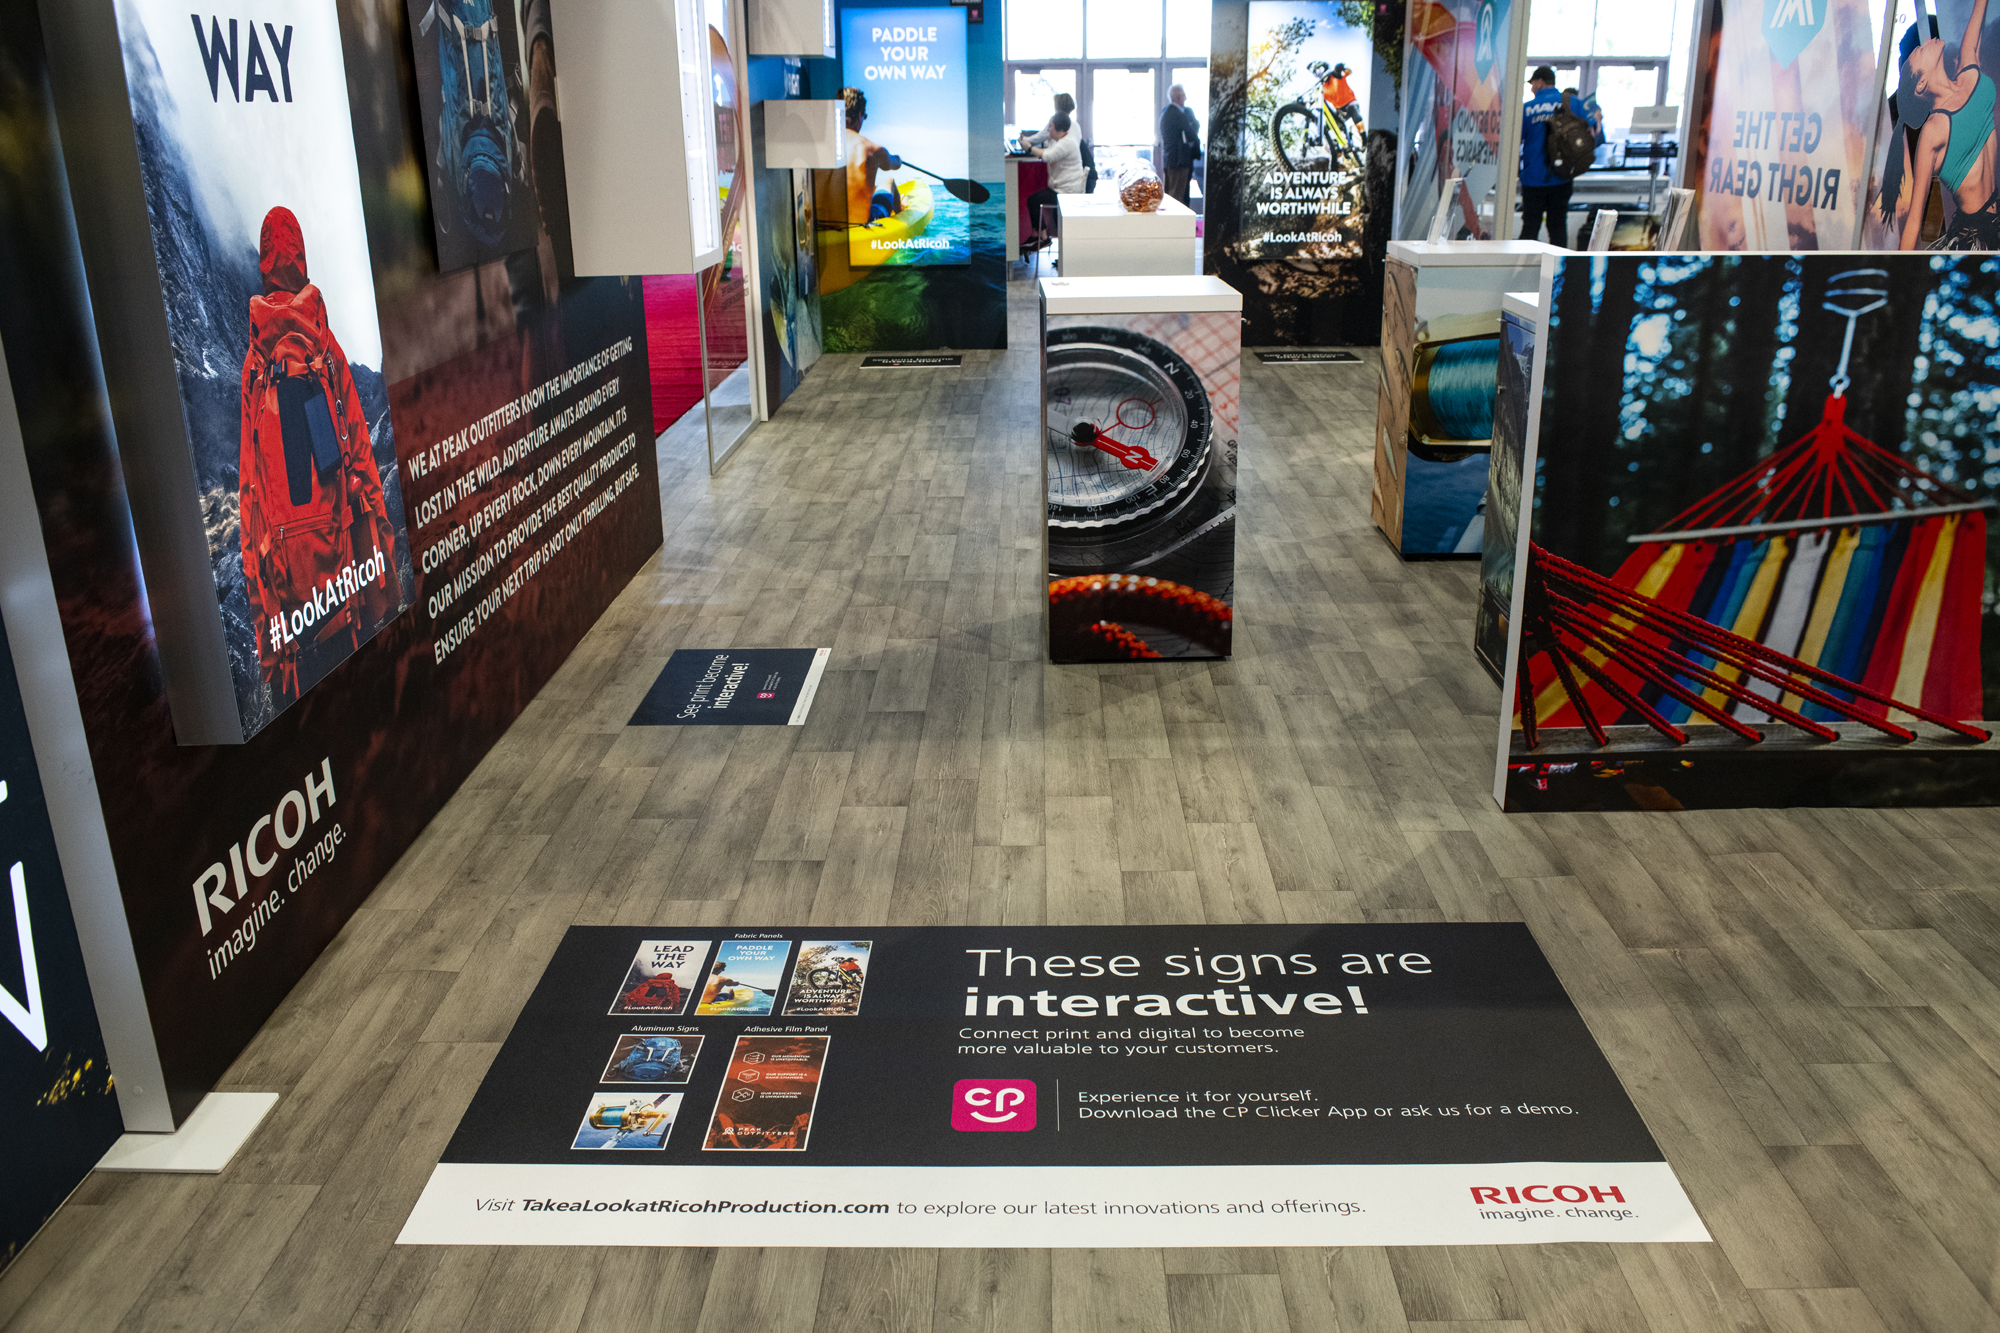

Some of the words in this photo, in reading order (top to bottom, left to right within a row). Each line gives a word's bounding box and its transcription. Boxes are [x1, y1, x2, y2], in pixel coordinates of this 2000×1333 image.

[872, 27, 937, 42] PADDLE
[190, 14, 294, 103] WAY
[880, 46, 928, 61] YOUR
[864, 65, 906, 80] OWN
[910, 64, 946, 80] WAY
[1263, 172, 1346, 185] ADVENTURE
[1270, 187, 1282, 200] IS
[1285, 187, 1338, 200] ALWAYS
[1256, 202, 1352, 215] WORTHWHILE
[870, 238, 950, 250] #LookAtRicoh
[1262, 232, 1342, 243] #LookAtRicoh
[1164, 362, 1180, 375] N
[1184, 390, 1194, 400] 20
[408, 452, 428, 482] WE
[429, 444, 440, 472] AT
[442, 428, 470, 462] PEAK
[470, 399, 520, 445] OUTFITTERS
[520, 386, 546, 417] KNOW
[545, 377, 560, 400] THE
[560, 359, 601, 394] IMPORTANCE
[600, 348, 610, 371] OF
[609, 336, 633, 366] GETTING
[1190, 420, 1198, 429] 40
[415, 495, 442, 528] LOST
[444, 486, 456, 511] IN
[456, 469, 476, 500] THE
[476, 454, 502, 488] WILD.
[502, 422, 549, 470] ADVENTURE
[550, 407, 574, 438] AWAITS
[575, 390, 602, 422] AROUND
[601, 376, 620, 405] EVERY
[1125, 449, 1143, 464] N
[1180, 448, 1190, 458] 60
[1160, 474, 1170, 484] 80
[422, 525, 470, 574] CORNER,
[469, 512, 483, 537] UP
[484, 488, 512, 528] EVERY
[512, 472, 538, 505] ROCK,
[538, 458, 562, 488] DOWN
[562, 438, 584, 470] EVERY
[620, 406, 628, 423] IS
[1146, 484, 1158, 496] E
[1126, 494, 1140, 504] 100
[428, 583, 452, 619] OUR
[454, 548, 494, 600] MISSION
[494, 539, 507, 564] TO
[507, 512, 543, 554] PROVIDE
[542, 494, 558, 523] THE
[557, 483, 574, 514] BEST
[574, 462, 600, 498] QUALITY
[599, 442, 629, 479] PRODUCTS
[628, 432, 636, 450] TO
[434, 611, 476, 665] ENSURE
[475, 587, 501, 626] YOUR
[502, 566, 524, 602] NEXT
[523, 551, 542, 582] TRIP
[542, 543, 550, 564] IS
[550, 529, 565, 557] NOT
[564, 514, 582, 542] ONLY
[582, 486, 616, 526] THRILLING,
[615, 476, 626, 498] BUT
[626, 462, 640, 488] SAFE.
[269, 545, 386, 652] #LookAtRicoh
[696, 654, 729, 684] become
[690, 684, 711, 703] print
[707, 663, 749, 709] interactive!
[676, 704, 701, 719] See
[192, 756, 336, 938] RICOH
[208, 890, 286, 980] imagine.
[288, 823, 346, 892] change.
[966, 947, 1140, 977] These
[1165, 947, 1317, 984] signs
[1341, 952, 1432, 975] are
[965, 986, 1369, 1017] interactive!
[959, 1027, 1039, 1039] Connect
[1045, 1027, 1090, 1041] print
[1096, 1027, 1131, 1039] and
[1138, 1027, 1196, 1042] digital
[1203, 1027, 1223, 1039] to
[1229, 1026, 1304, 1039] become
[958, 1045, 1007, 1054] more
[1013, 1043, 1092, 1054] valuable
[1098, 1044, 1119, 1054] to
[1125, 1046, 1169, 1057] your
[1175, 1044, 1278, 1054] customers.
[1079, 1091, 1180, 1105] Experience
[1186, 1090, 1199, 1102] it
[1204, 1090, 1232, 1102] for
[1238, 1090, 1318, 1104] yourself.
[1079, 1107, 1178, 1119] Download
[1184, 1107, 1216, 1118] the
[1223, 1107, 1249, 1118] CP
[1256, 1106, 1320, 1118] Clicker
[1328, 1106, 1368, 1119] App
[1374, 1107, 1393, 1117] or
[1401, 1105, 1432, 1116] ask
[1438, 1106, 1460, 1116] us
[1465, 1104, 1493, 1115] for
[1500, 1106, 1512, 1115] a
[1518, 1103, 1579, 1115] demo.
[1470, 1185, 1626, 1205] RICOH
[476, 1198, 515, 1212] Visit
[522, 1199, 889, 1214] TakeaLookatRicohProduction.com
[897, 1201, 917, 1215] to
[923, 1202, 997, 1217] explore
[1003, 1203, 1037, 1214] our
[1044, 1201, 1097, 1214] latest
[1104, 1201, 1220, 1214] innovations
[1226, 1200, 1264, 1213] and
[1271, 1200, 1366, 1216] offerings.
[1480, 1208, 1560, 1221] imagine.
[1565, 1207, 1639, 1221] change.
